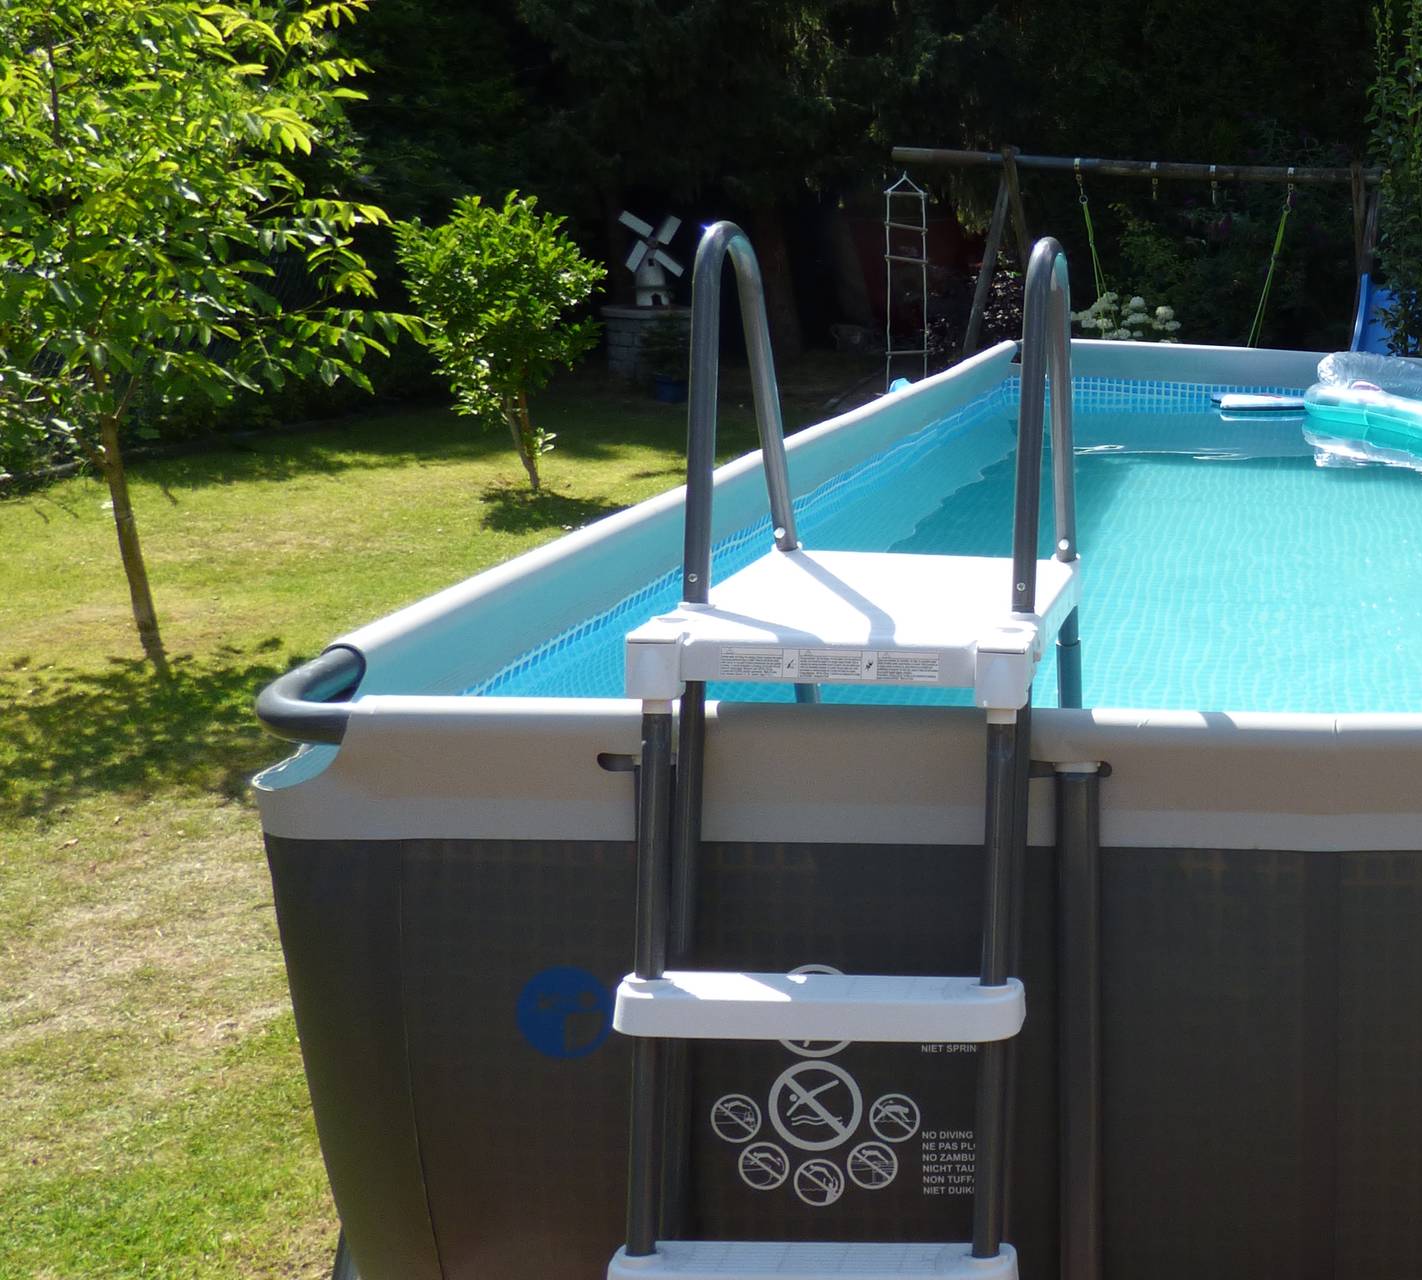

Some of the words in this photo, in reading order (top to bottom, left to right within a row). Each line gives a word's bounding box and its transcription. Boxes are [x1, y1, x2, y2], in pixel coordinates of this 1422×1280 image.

[921, 1044, 944, 1053] NIET
[946, 1044, 977, 1053] SPRIN
[921, 1131, 937, 1139] NO
[939, 1131, 974, 1140] DIVING
[921, 1142, 936, 1150] NE
[938, 1142, 959, 1150] PAS
[922, 1153, 938, 1162] NO
[939, 1153, 976, 1162] ZAMBU
[922, 1164, 953, 1173] NICHT
[954, 1164, 975, 1173] TAU
[922, 1175, 945, 1184] NON
[923, 1186, 946, 1195] NIET
[948, 1186, 975, 1195] DUIK
